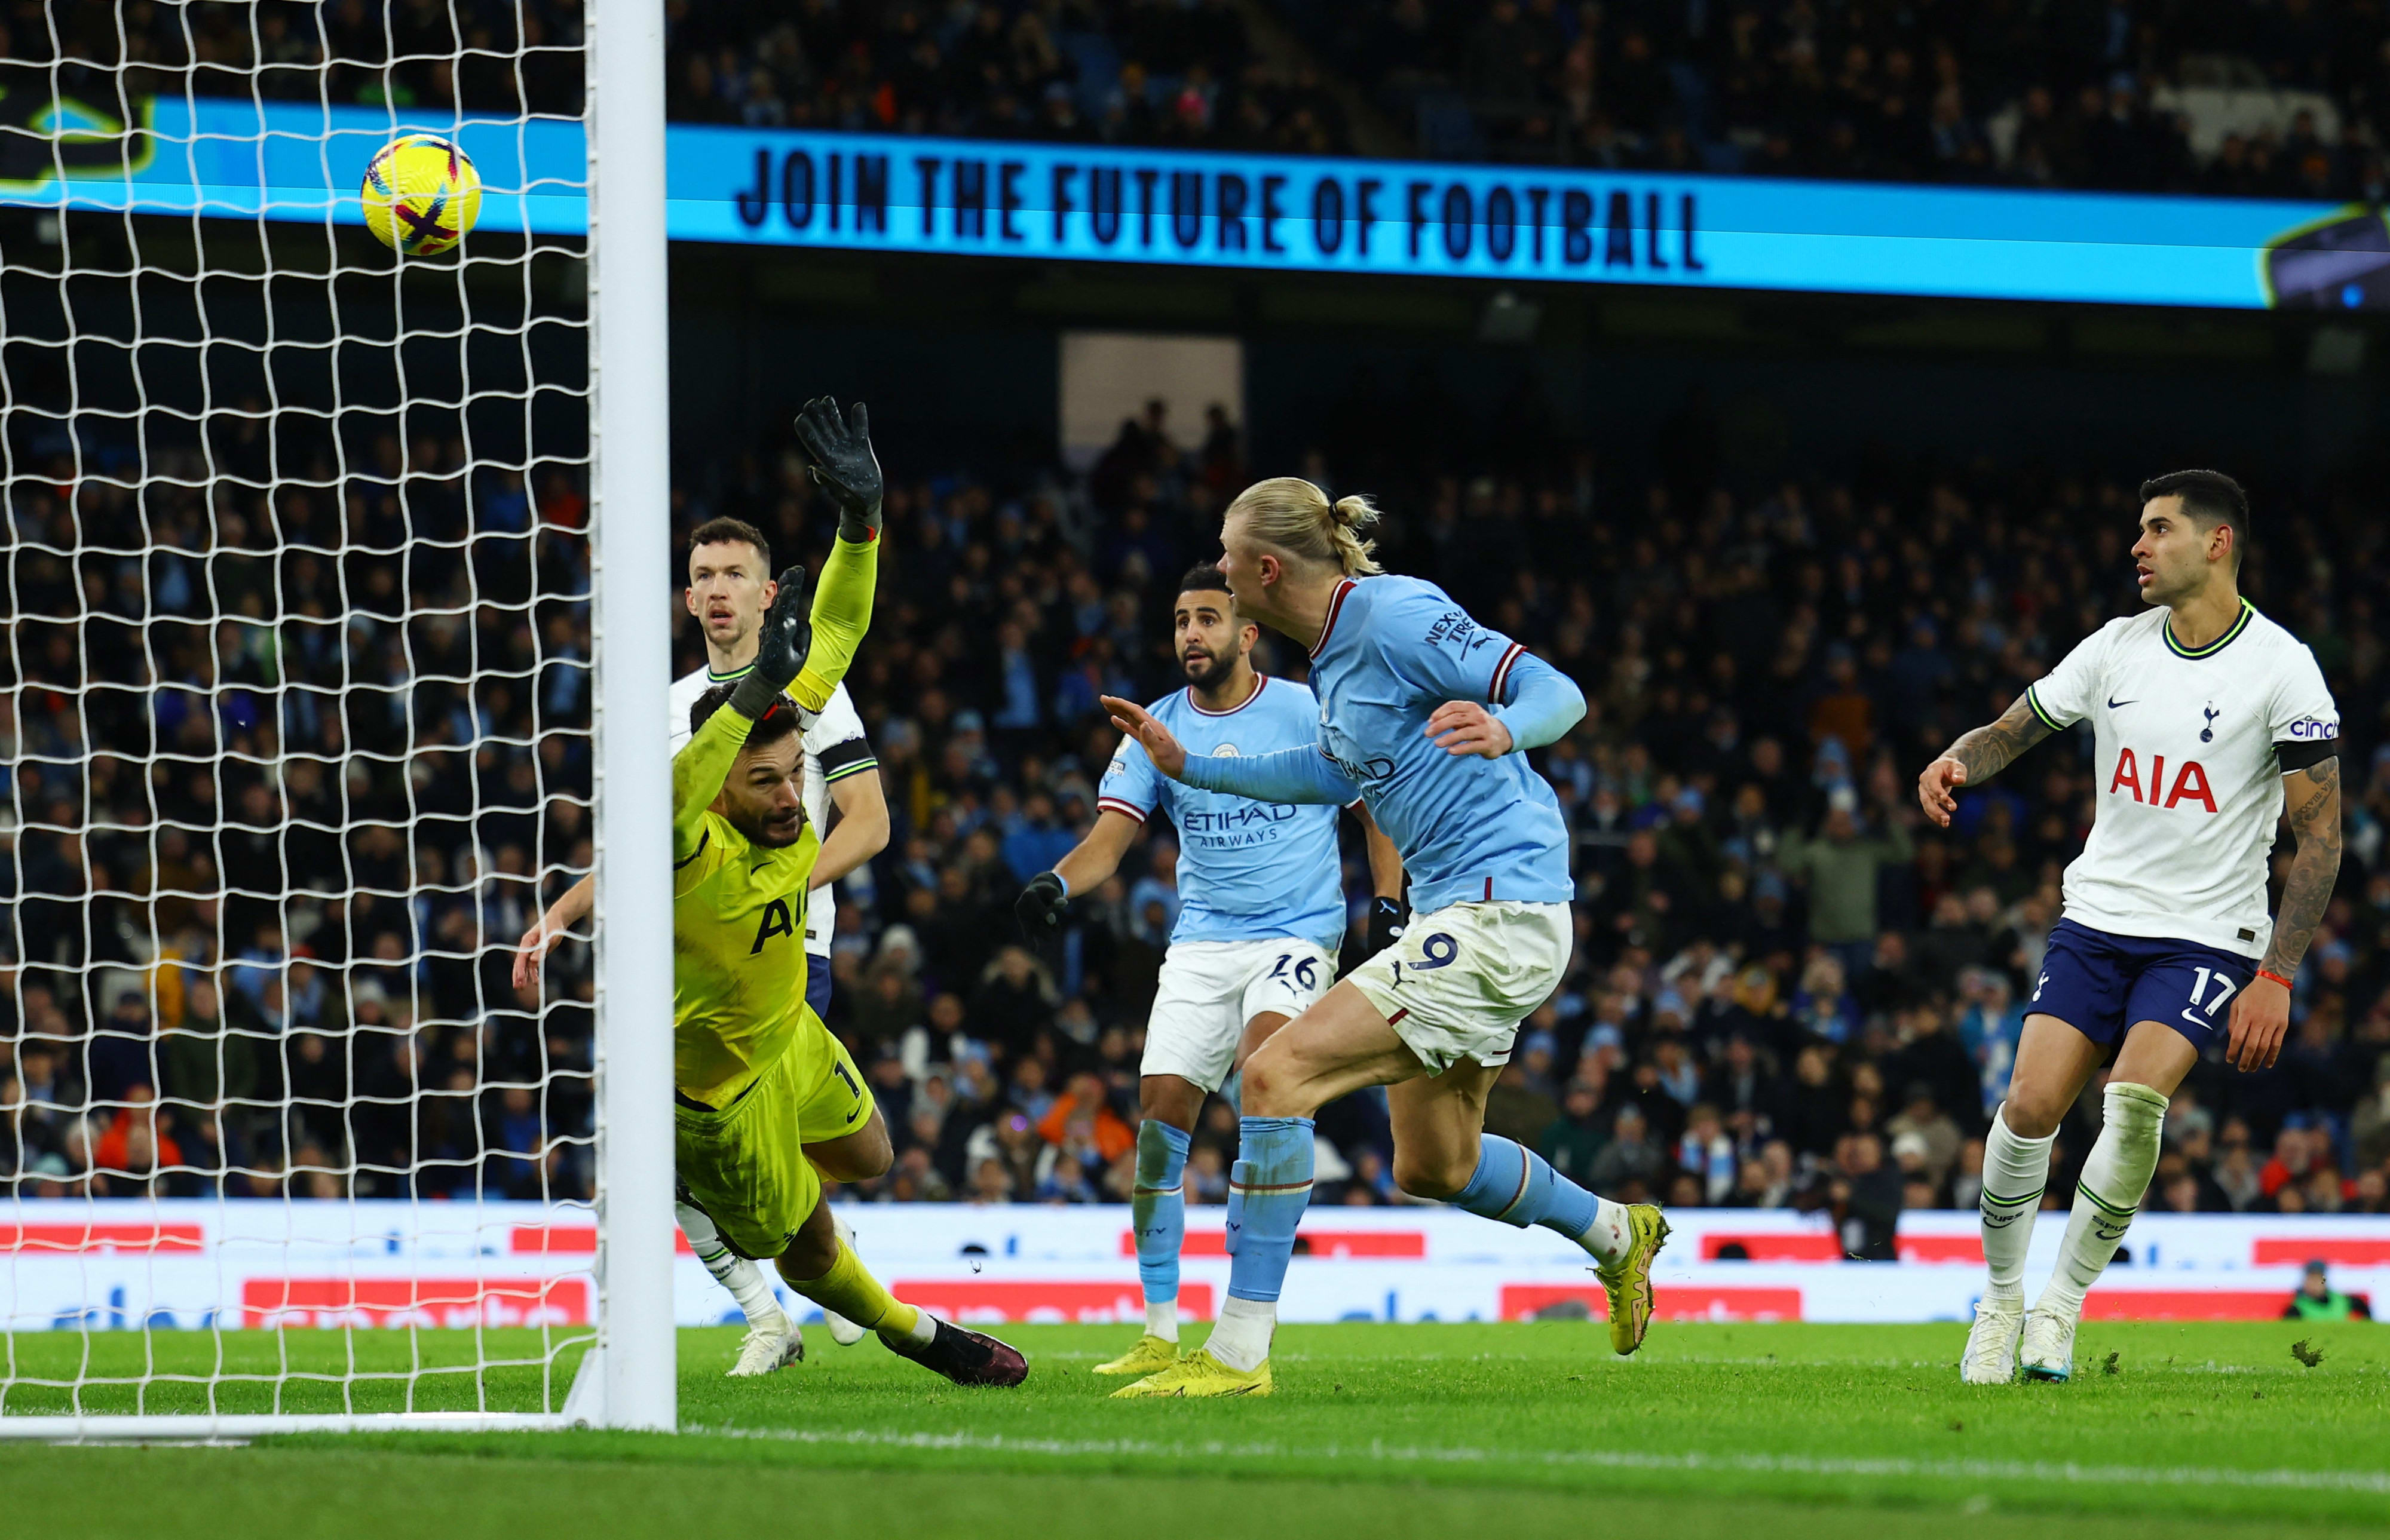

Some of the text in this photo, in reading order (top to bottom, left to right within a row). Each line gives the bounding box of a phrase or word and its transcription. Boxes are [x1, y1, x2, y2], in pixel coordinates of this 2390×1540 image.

[736, 148, 1706, 272] JOIN THE FUTURE OF FOOTBALL
[1446, 616, 1475, 643] TIRE
[2110, 748, 2218, 813] AIA
[1184, 804, 1297, 832] ETIHAD
[1200, 829, 1277, 847] AIRWAYS
[750, 876, 809, 955] AI
[1407, 933, 1458, 970] 9
[2189, 967, 2237, 1017] 17
[834, 1060, 860, 1099] 1
